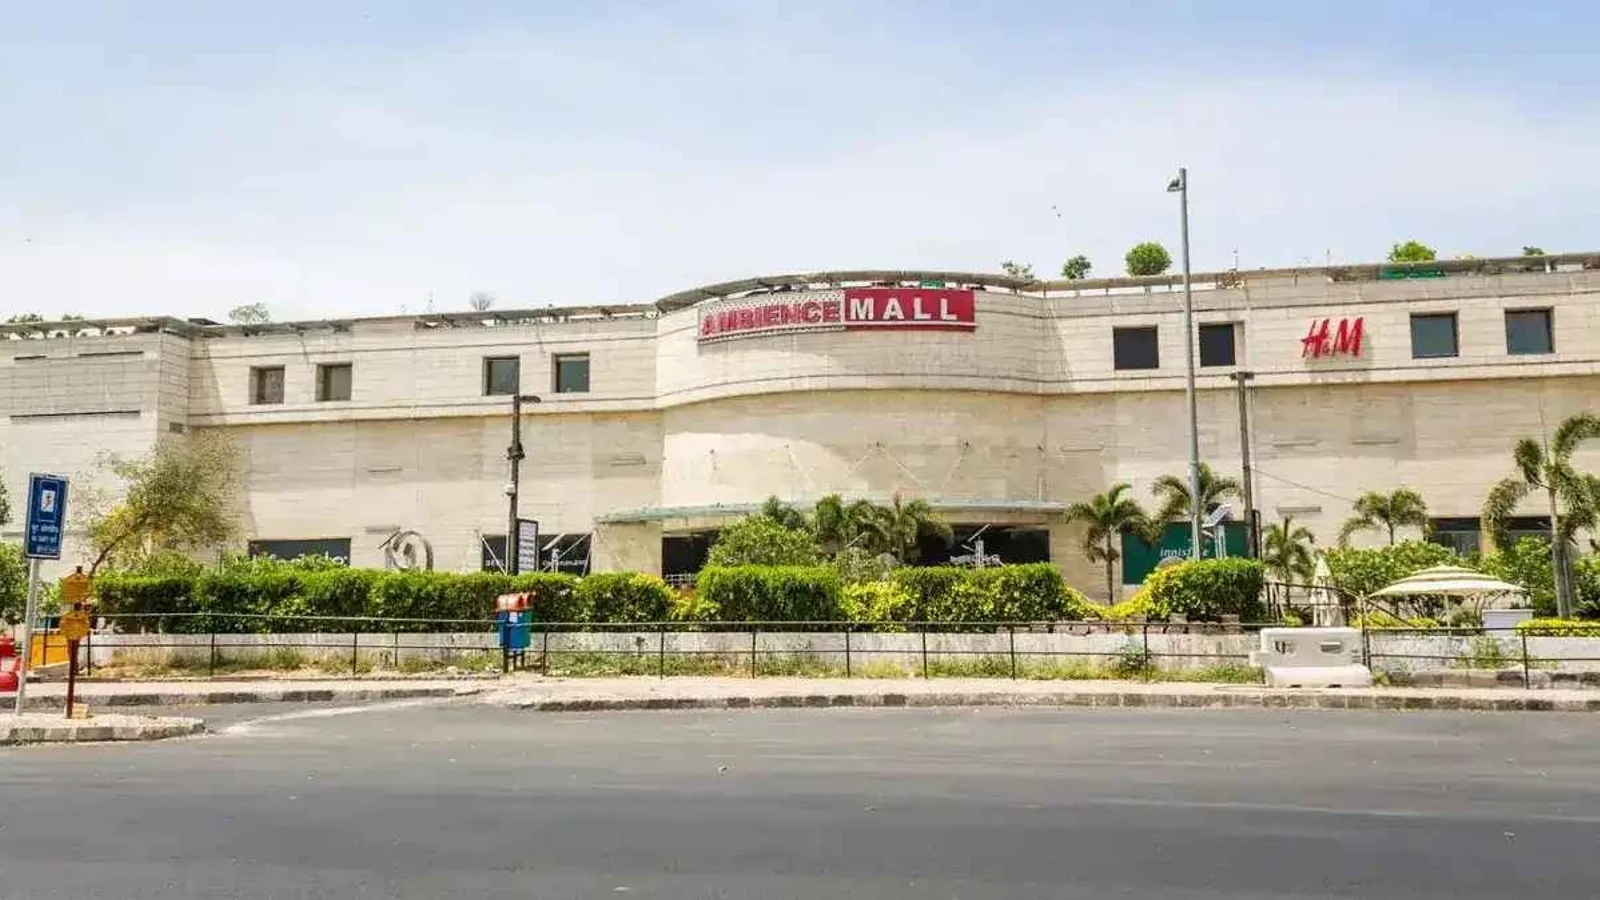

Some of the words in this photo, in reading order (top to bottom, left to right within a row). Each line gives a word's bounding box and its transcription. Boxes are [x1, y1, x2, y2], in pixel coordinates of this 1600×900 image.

[702, 299, 840, 336] AMBIENCE
[850, 298, 957, 321] MALL
[1301, 317, 1363, 358] H&M
